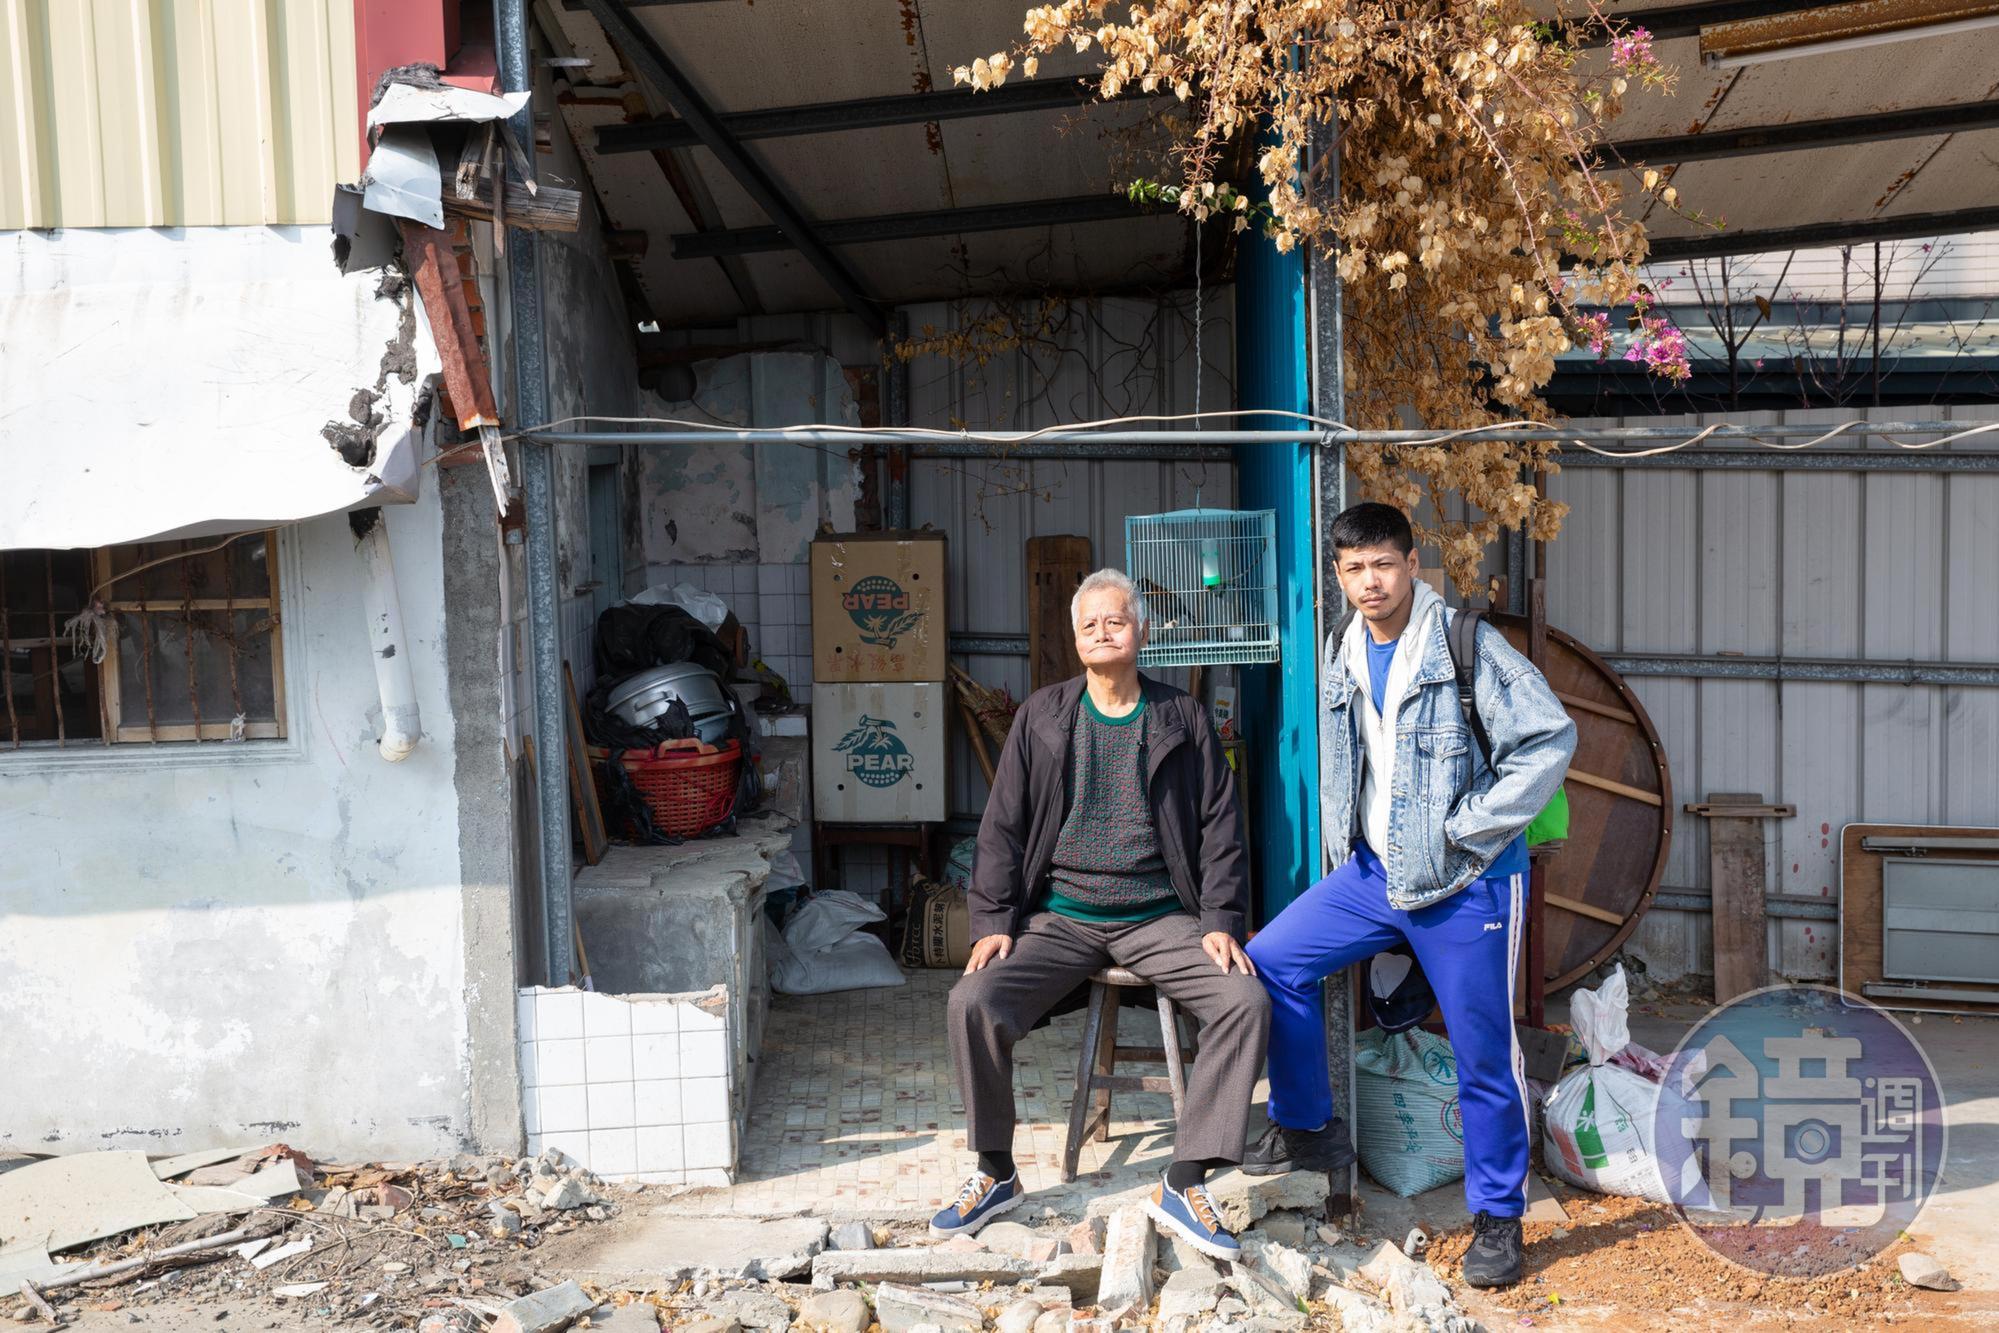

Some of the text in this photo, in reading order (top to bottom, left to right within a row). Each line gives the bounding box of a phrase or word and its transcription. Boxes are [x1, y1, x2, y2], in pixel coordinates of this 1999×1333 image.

[842, 592, 910, 611] PEAR
[847, 752, 914, 771] PEAR
[1484, 922, 1503, 931] FILA
[1393, 1093, 1422, 1153] 四季平安
